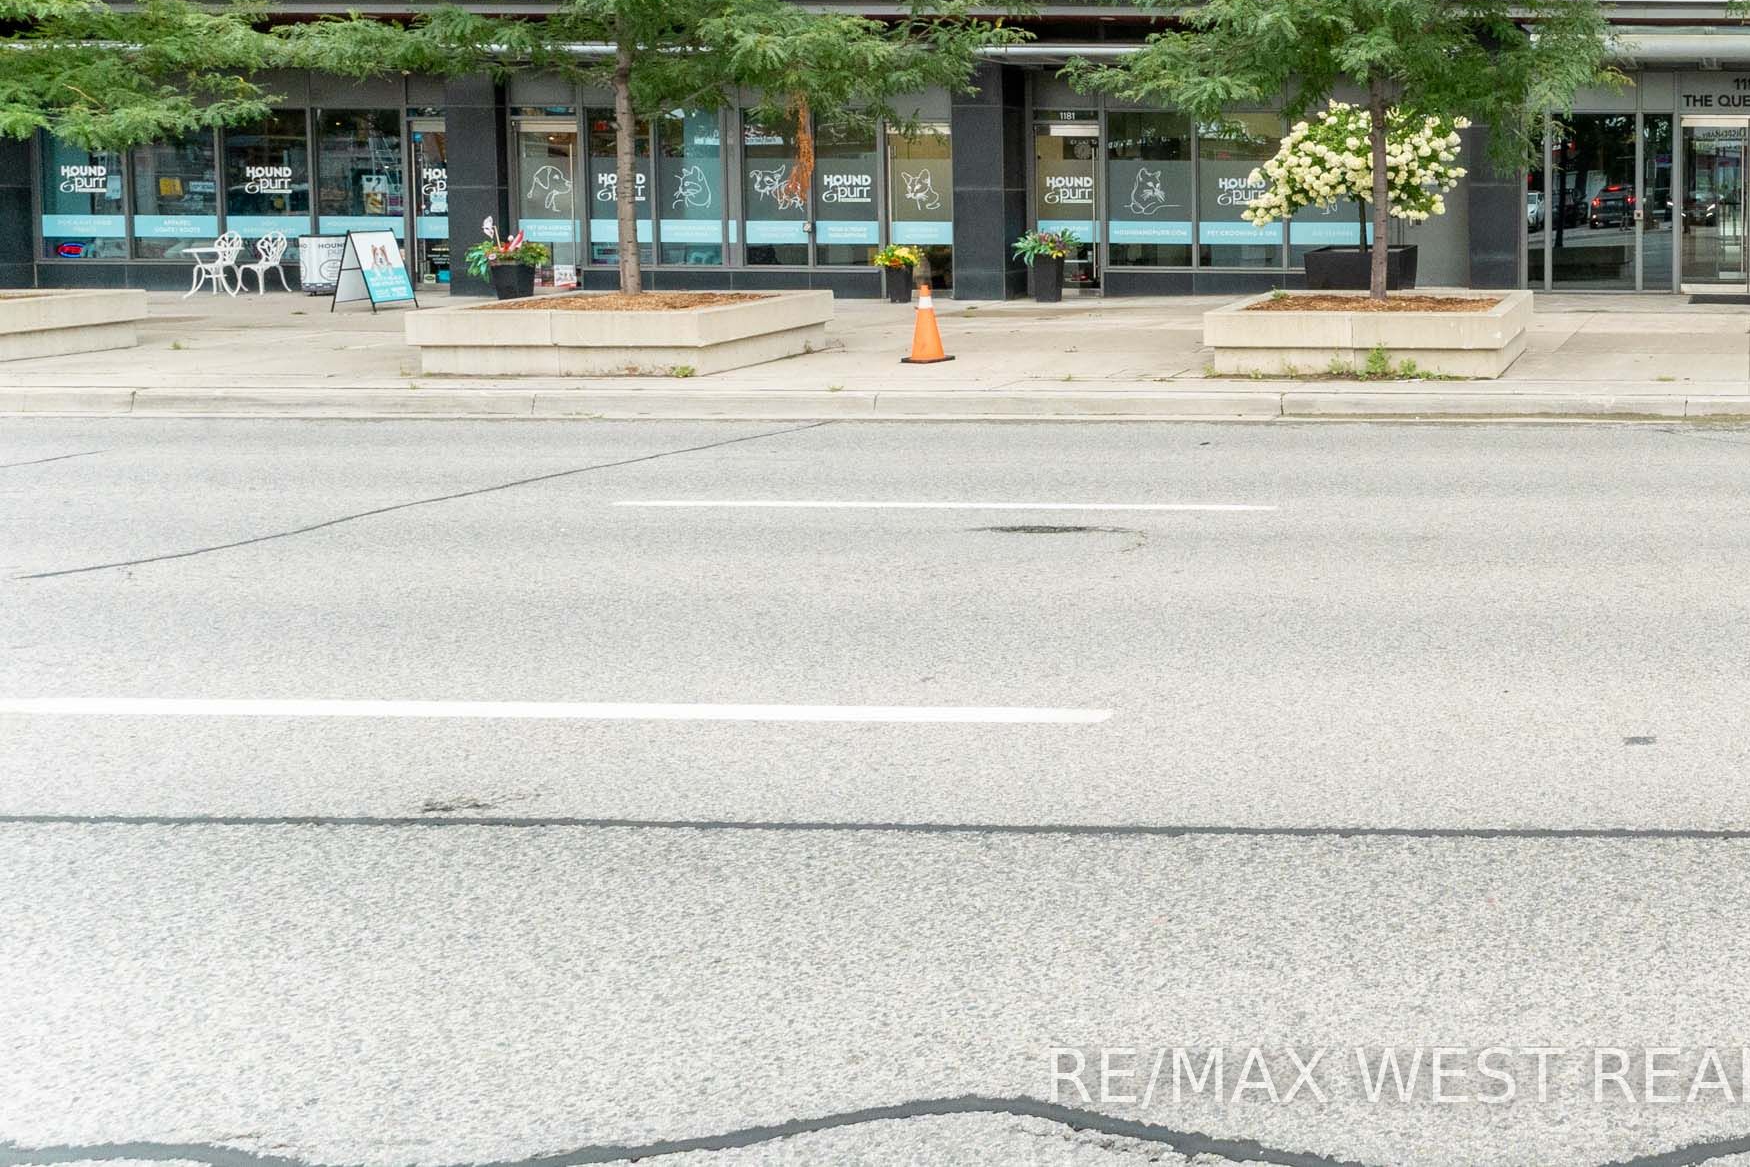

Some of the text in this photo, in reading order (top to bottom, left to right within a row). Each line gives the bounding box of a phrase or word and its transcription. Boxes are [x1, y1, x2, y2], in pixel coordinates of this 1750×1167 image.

[1683, 94, 1713, 107] THE
[1060, 112, 1075, 120] 1181
[60, 165, 107, 178] HOUND
[245, 166, 292, 178] HOUND
[75, 177, 107, 192] purr
[598, 173, 646, 184] HOD
[823, 175, 872, 186] HOUND
[1046, 176, 1093, 188] HOUND
[260, 178, 292, 193] purr
[838, 186, 871, 202] purr
[1060, 188, 1092, 203] purr
